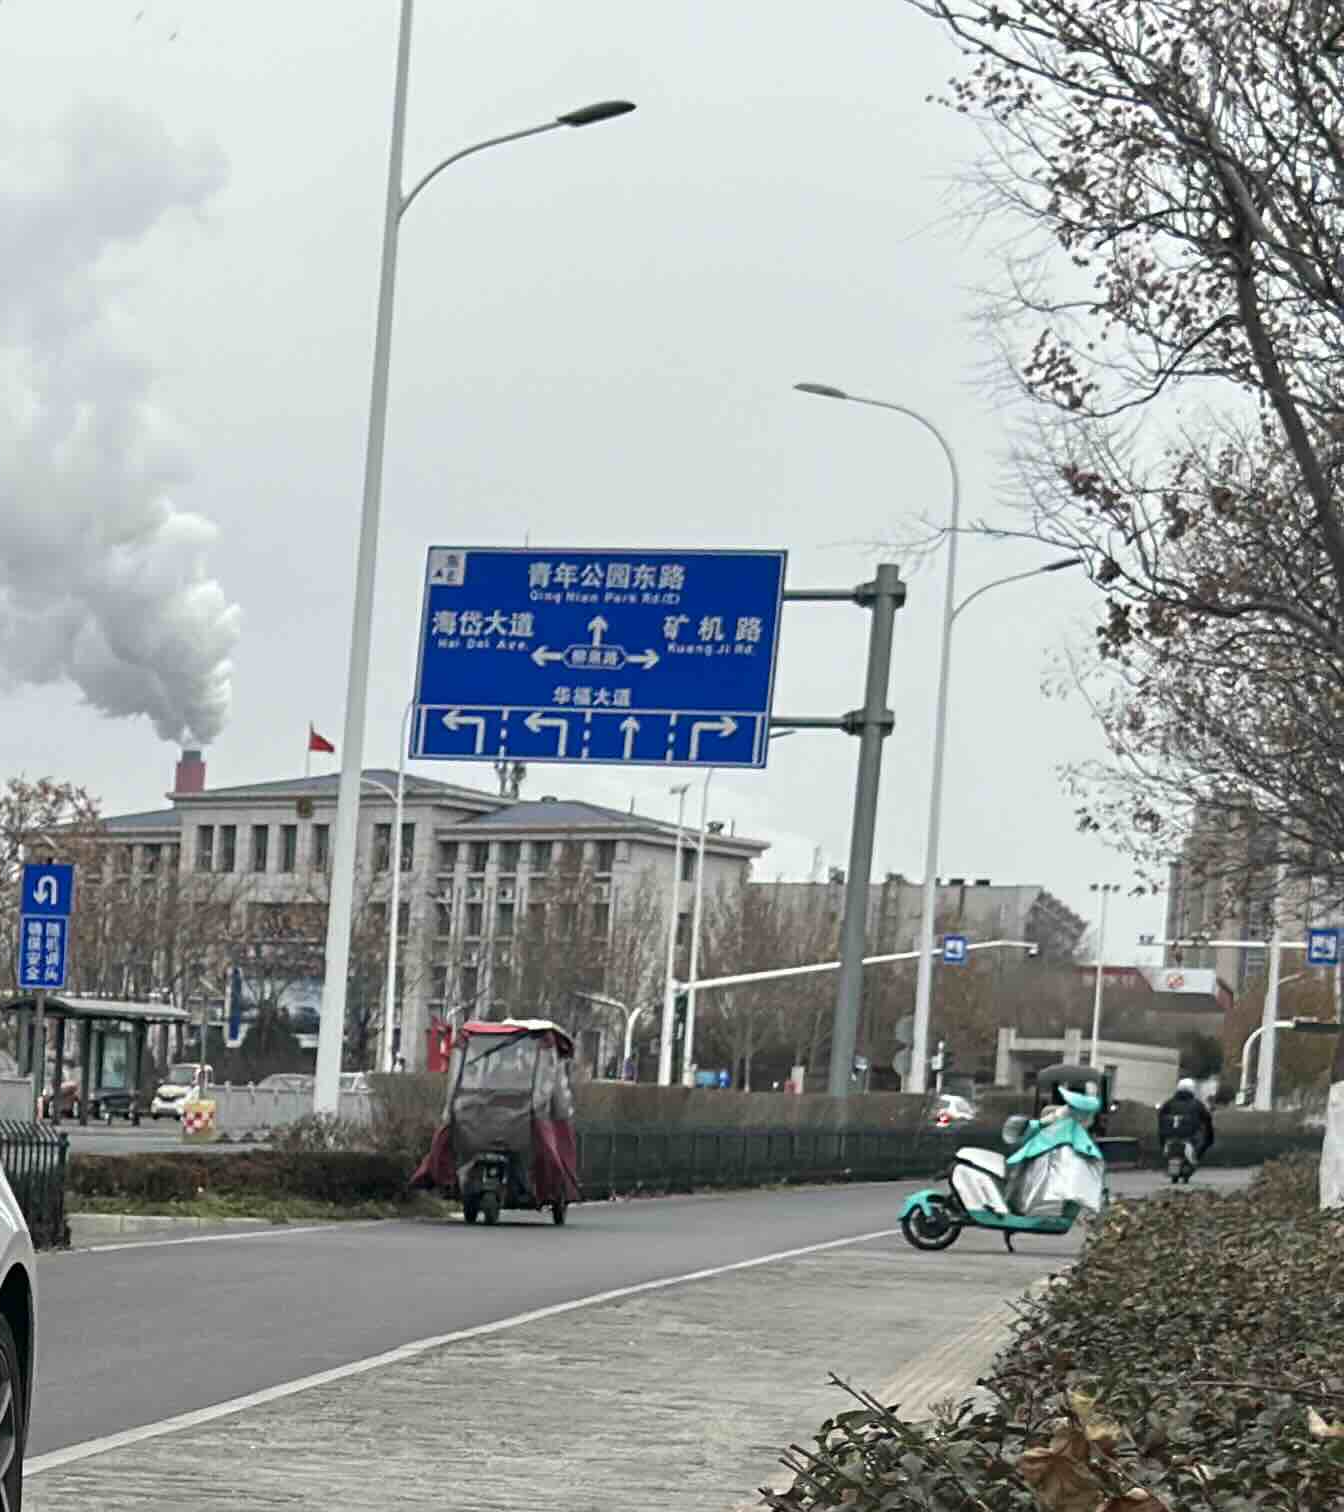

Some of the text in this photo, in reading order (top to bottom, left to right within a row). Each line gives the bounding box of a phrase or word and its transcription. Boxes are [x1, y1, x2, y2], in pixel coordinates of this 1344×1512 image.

[528, 562, 686, 590] 青年公园东路
[432, 609, 535, 637] 海岱大道
[663, 614, 763, 642] 矿机路
